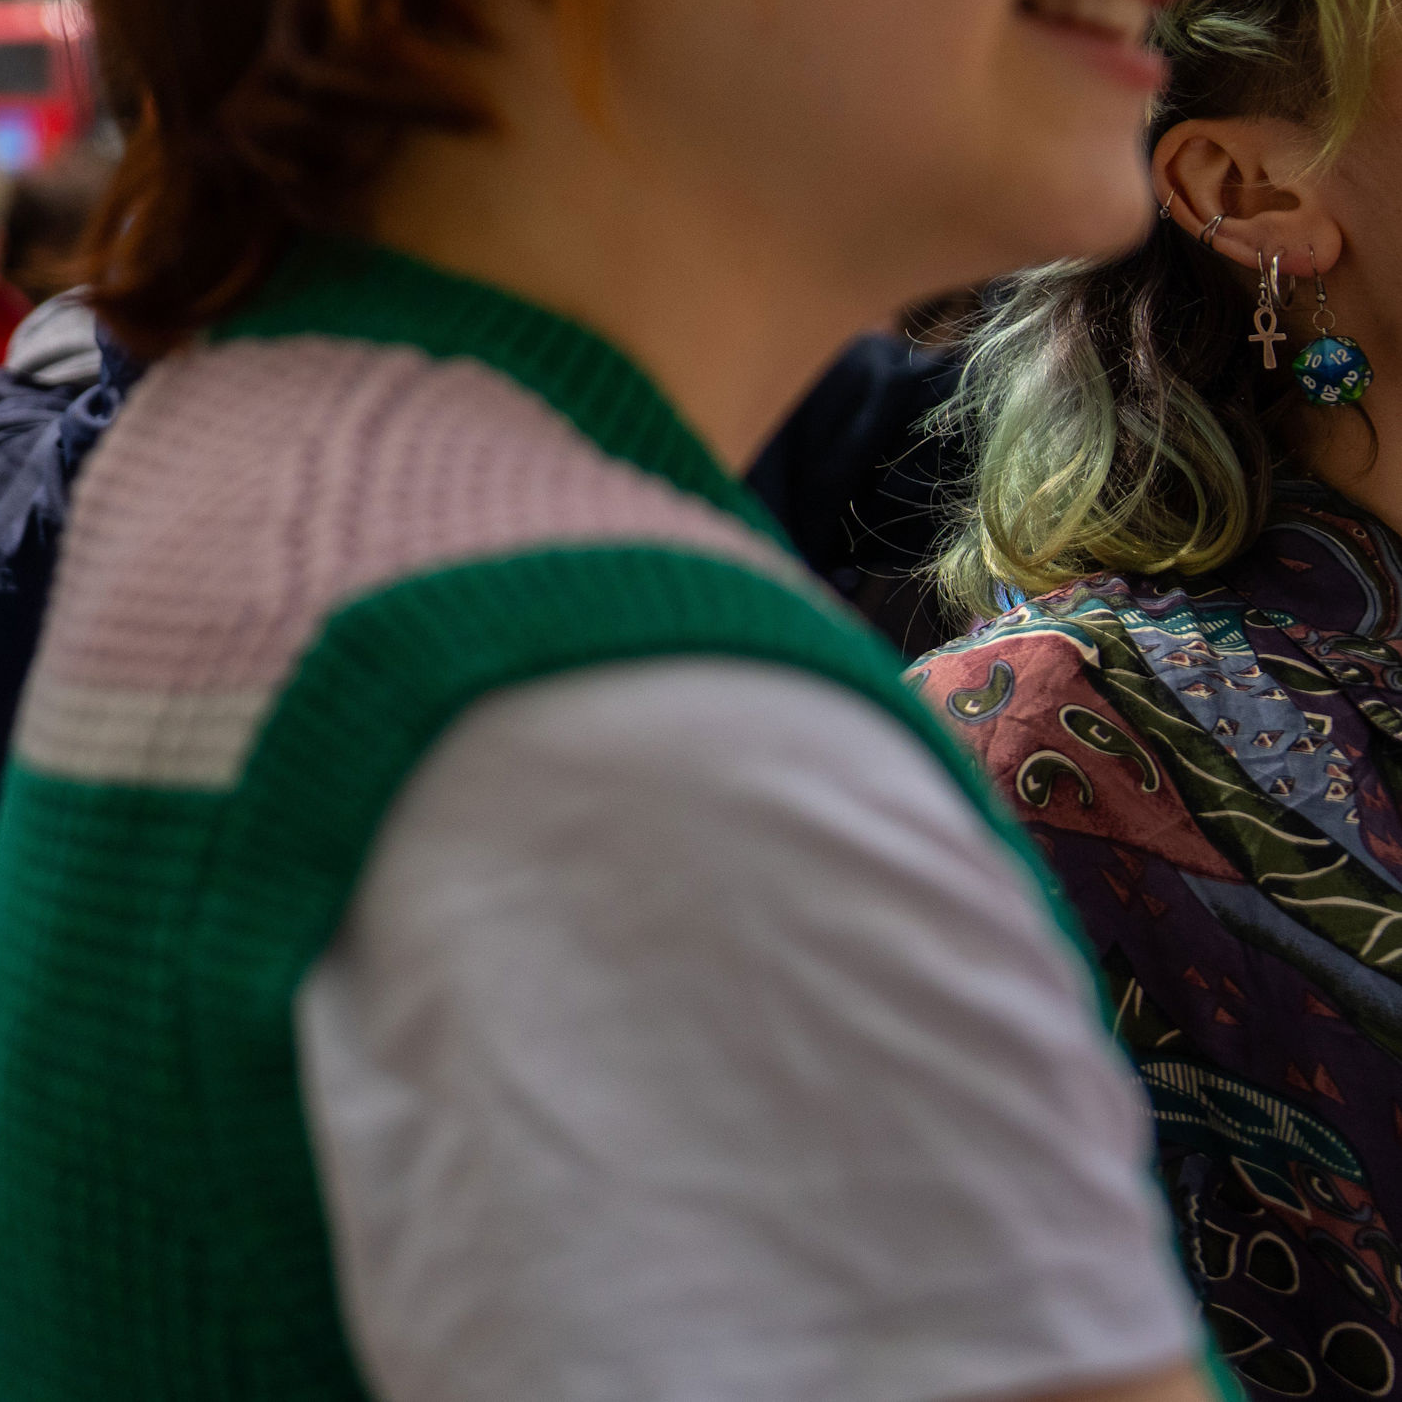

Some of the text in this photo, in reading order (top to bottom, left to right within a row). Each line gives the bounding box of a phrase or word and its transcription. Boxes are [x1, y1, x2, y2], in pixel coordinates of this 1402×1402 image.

[1304, 352, 1322, 368] 10
[1329, 348, 1352, 365] 12
[1302, 375, 1316, 389] 8
[1342, 370, 1358, 387] 2
